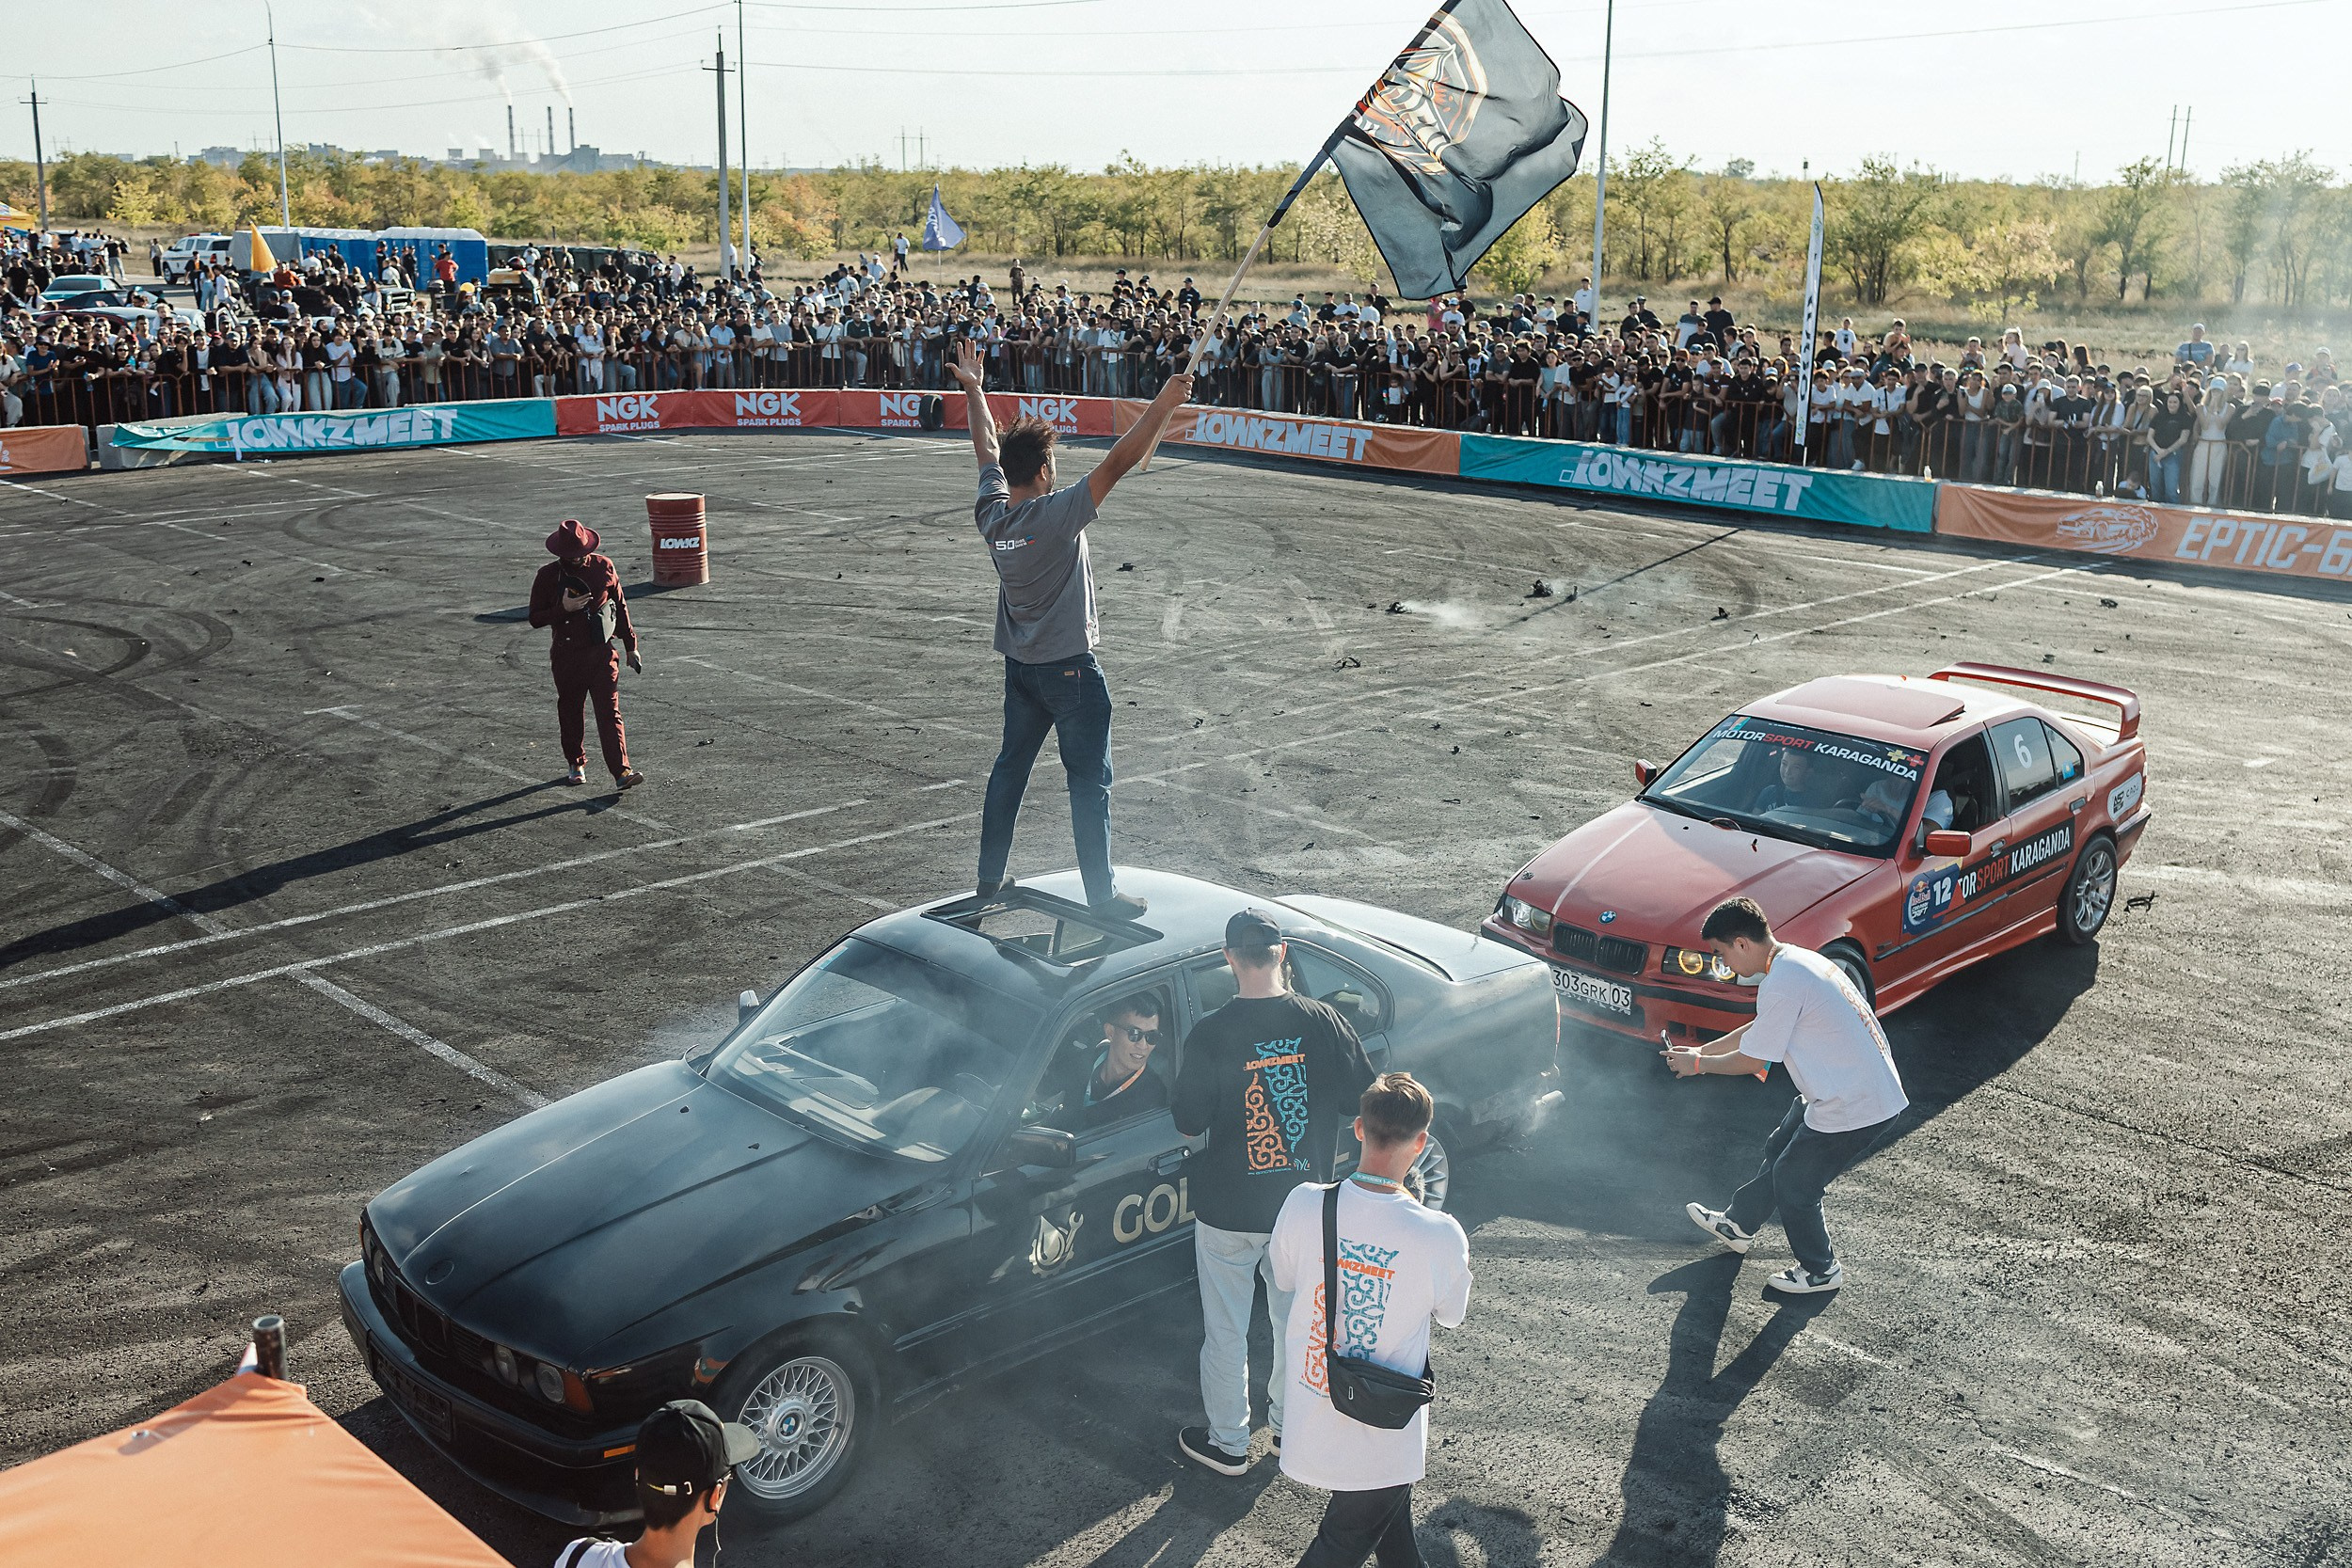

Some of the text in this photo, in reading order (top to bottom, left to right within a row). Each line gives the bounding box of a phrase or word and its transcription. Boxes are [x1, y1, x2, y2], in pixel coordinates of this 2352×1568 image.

[596, 393, 660, 422] NGK
[735, 391, 802, 417] NGK
[880, 393, 922, 418] NG
[1019, 397, 1078, 424] NGK
[227, 408, 458, 450] LOWKZMEET
[598, 420, 660, 433] SPARK PLUGS
[737, 418, 802, 427] SPARK PLUGS
[881, 419, 912, 427] SPARK
[1194, 411, 1374, 461] LOWKZMEET
[1571, 450, 1814, 512] LOWKZMEET
[994, 539, 1015, 551] 50
[2174, 515, 2352, 577] EPTIC-6
[1712, 729, 1918, 783] MOTORSPORT KARAGANDA
[2013, 733, 2033, 769] 6
[2010, 826, 2071, 875] KARAGANDA
[1932, 876, 1952, 907] 12
[1612, 987, 1630, 1007] 03
[1112, 1176, 1197, 1244] GOL
[1336, 1258, 1396, 1280] WKZMEET
